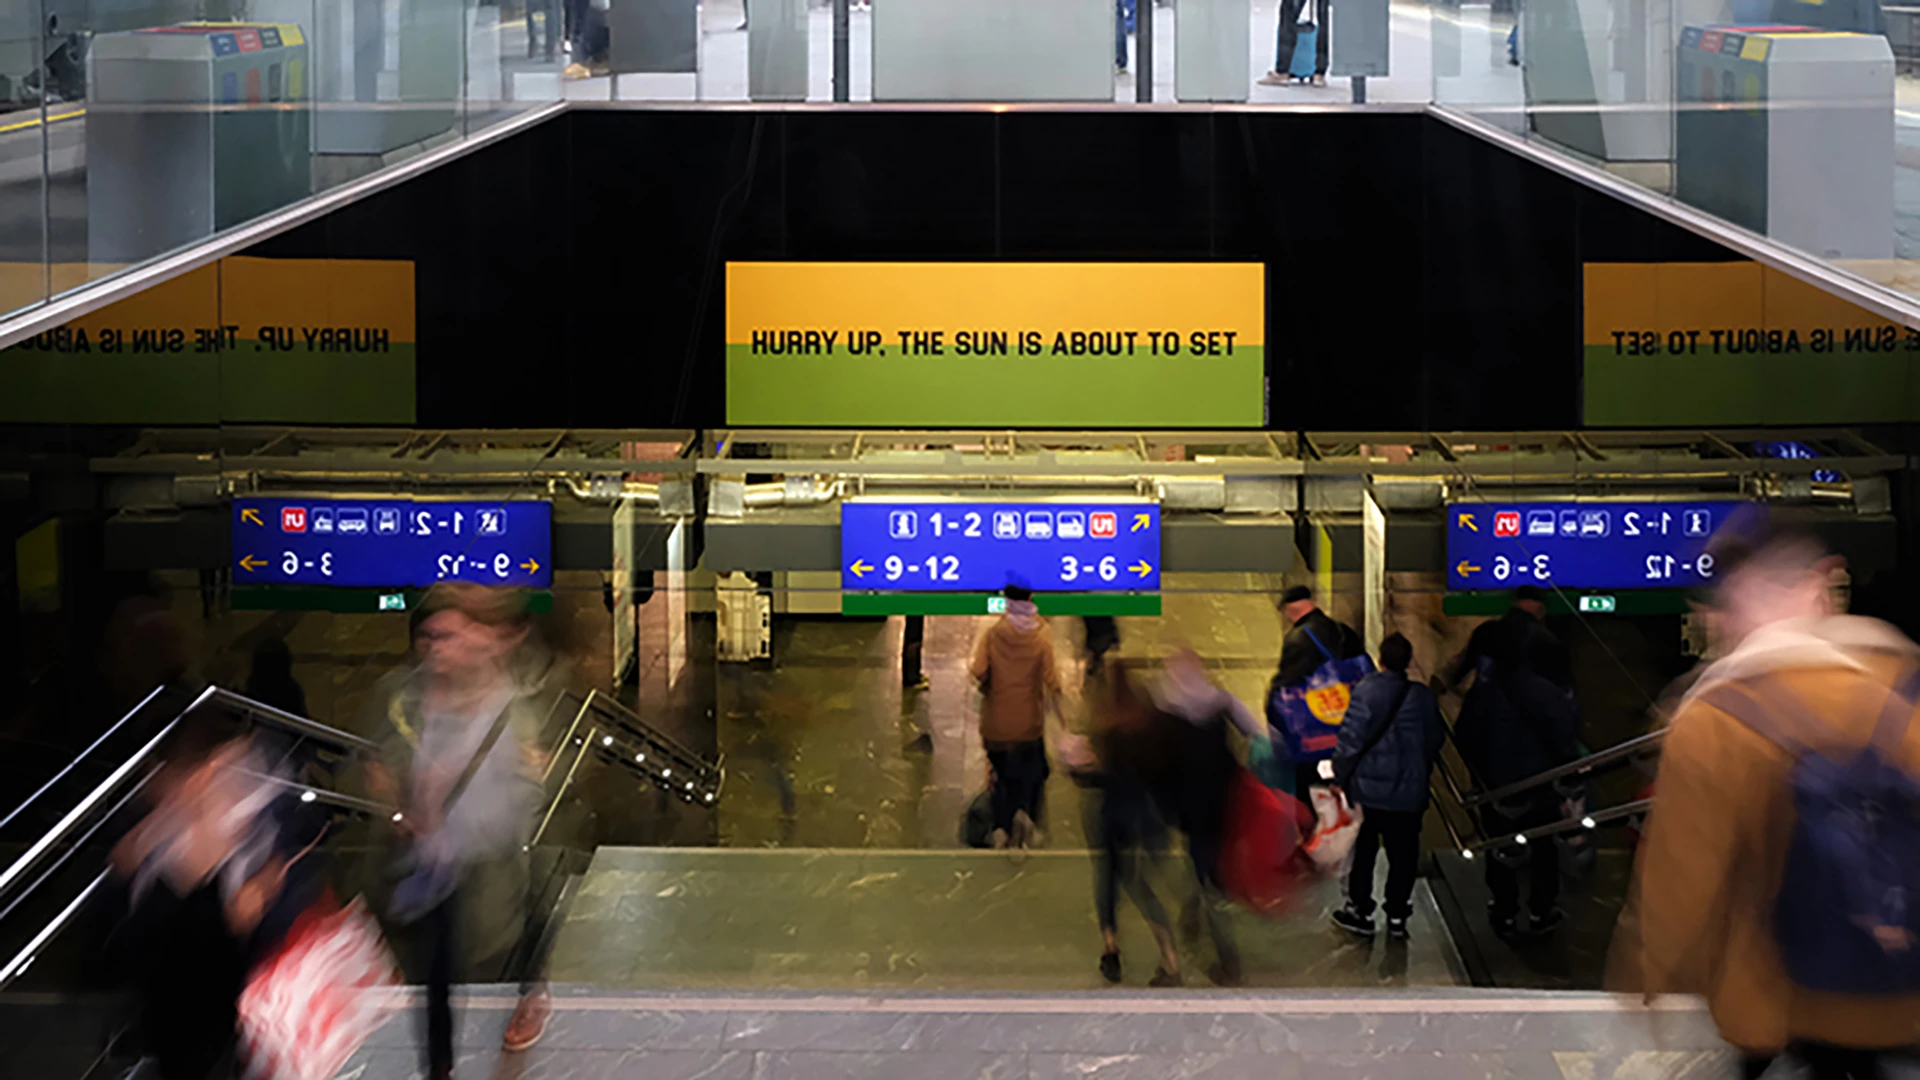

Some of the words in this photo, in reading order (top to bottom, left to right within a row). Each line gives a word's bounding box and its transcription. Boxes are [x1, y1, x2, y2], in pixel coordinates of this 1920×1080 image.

[751, 330, 838, 355] HURRY
[898, 331, 944, 356] THE
[954, 331, 1008, 356] SUN
[1018, 331, 1042, 356] IS
[1051, 331, 1138, 356] ABOUT
[1148, 331, 1180, 356] TO
[1189, 331, 1237, 356] SET
